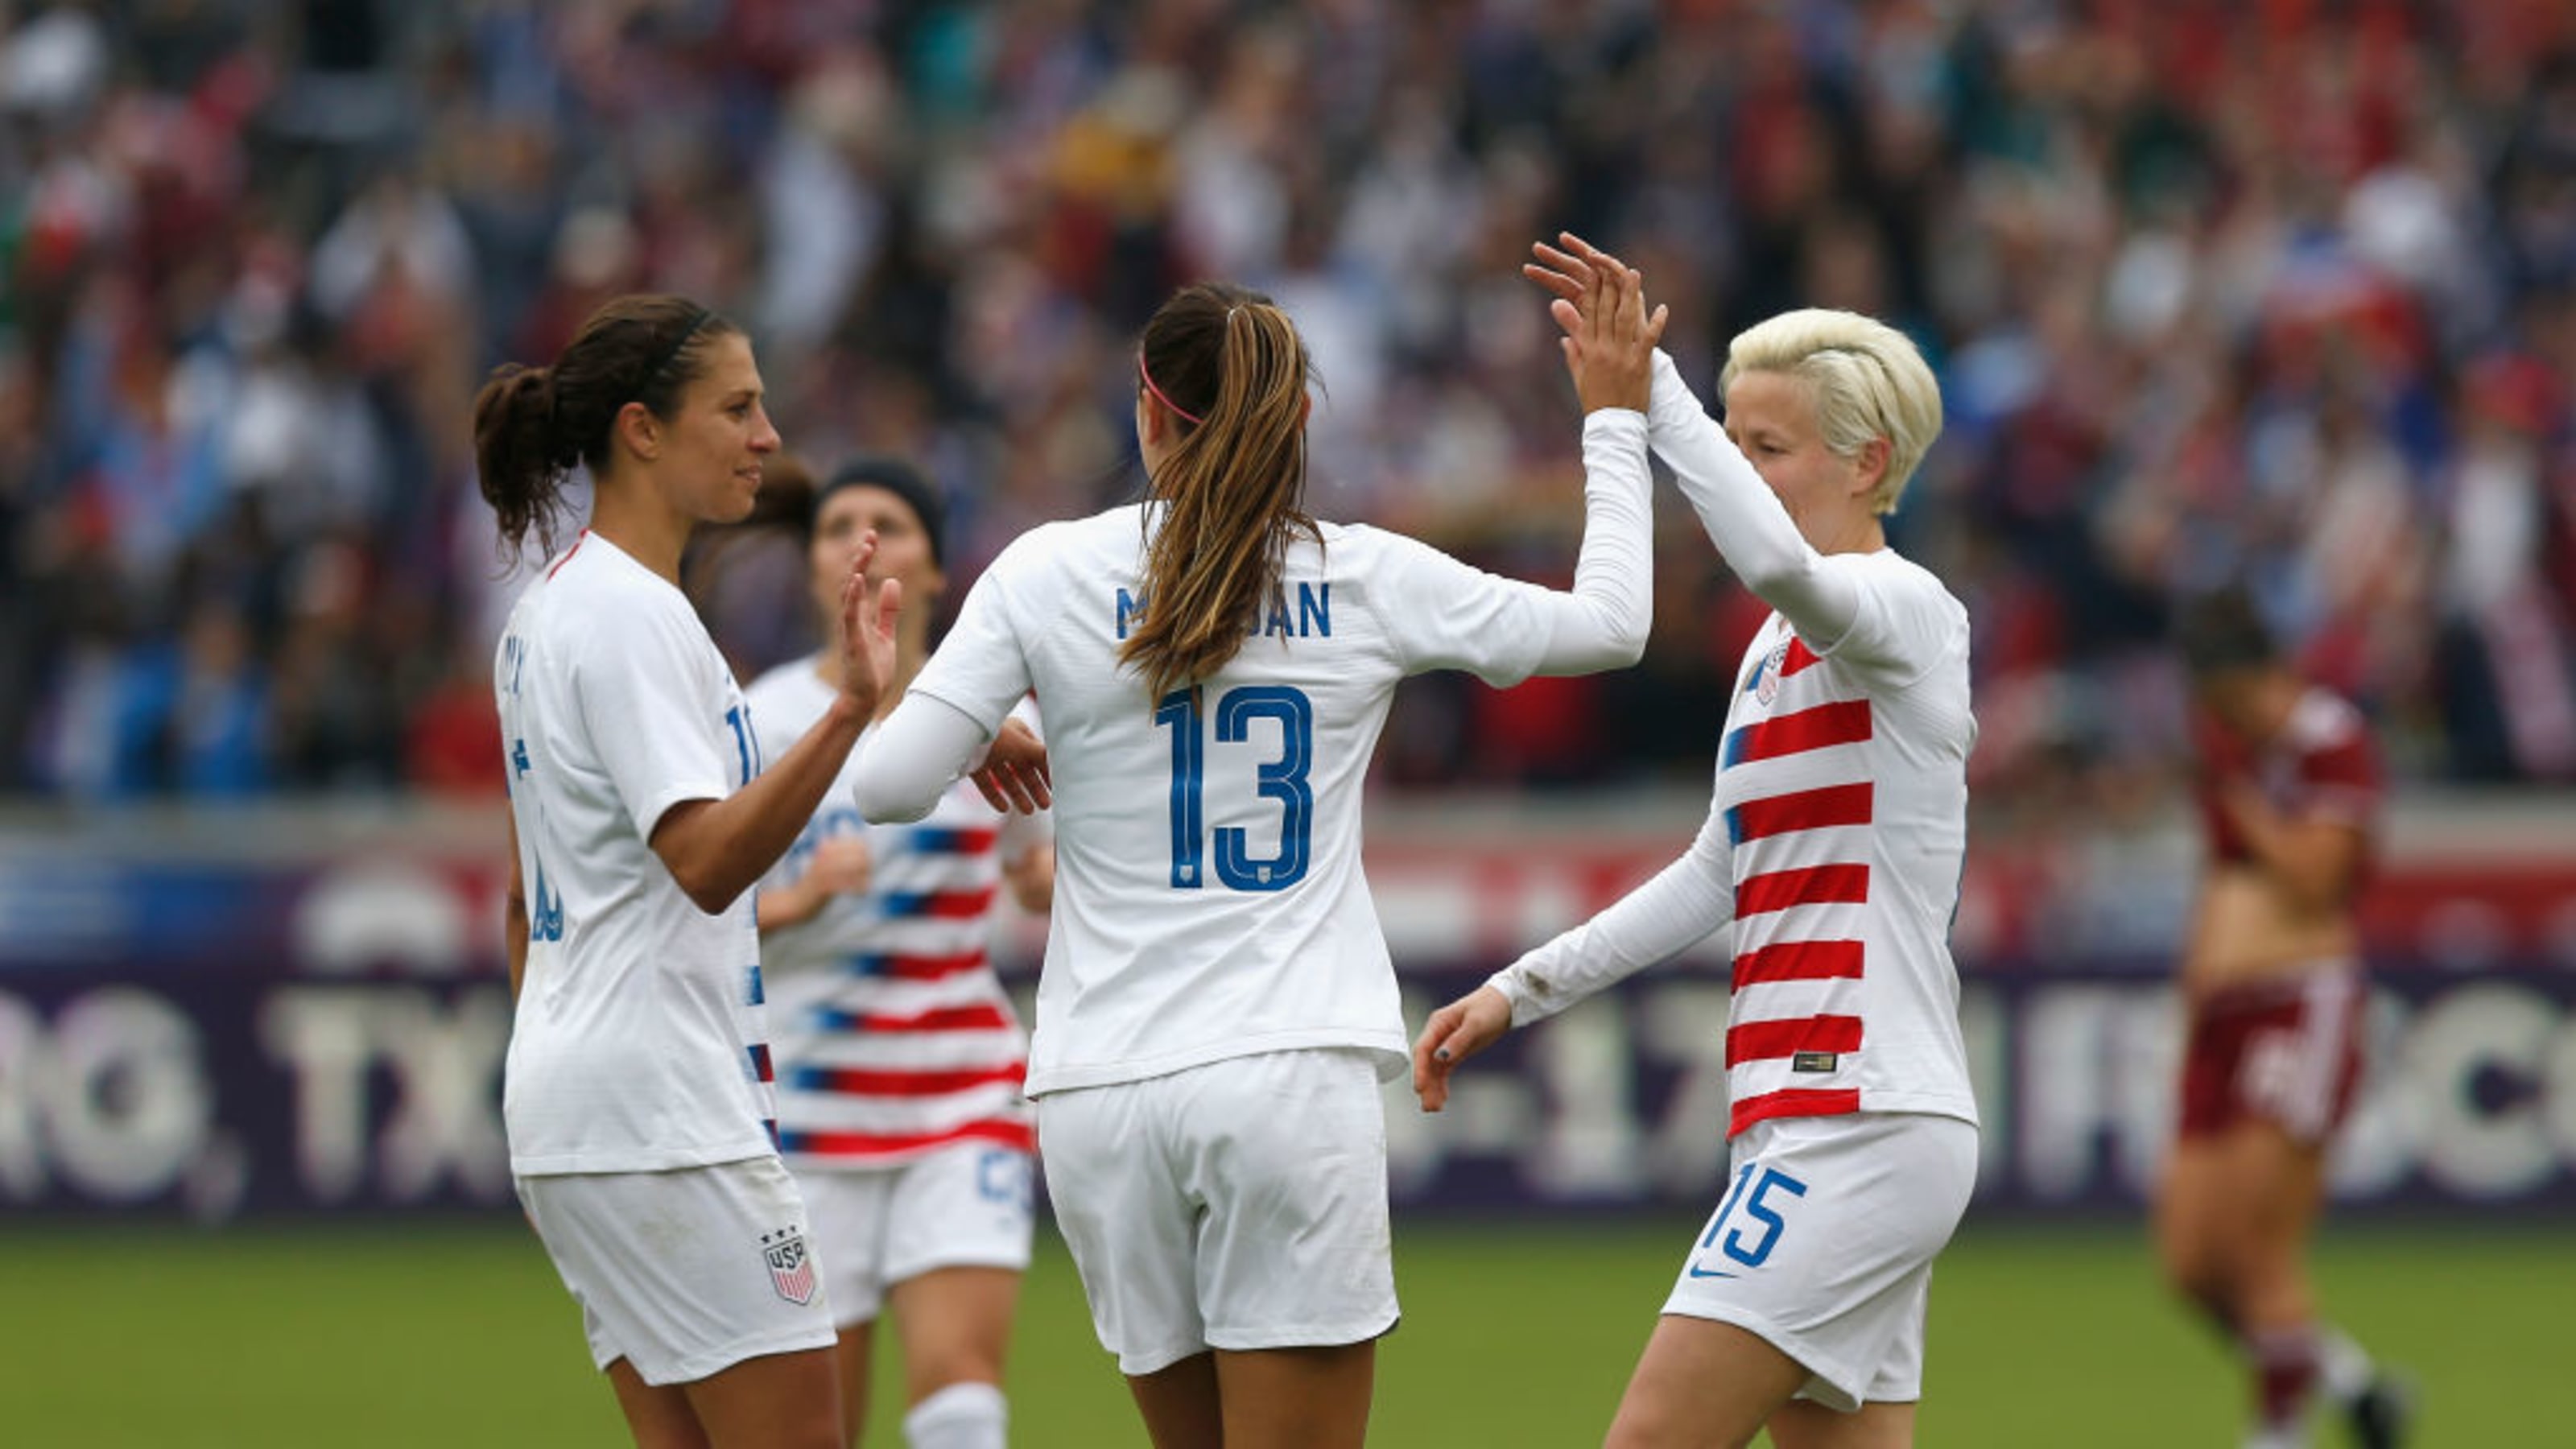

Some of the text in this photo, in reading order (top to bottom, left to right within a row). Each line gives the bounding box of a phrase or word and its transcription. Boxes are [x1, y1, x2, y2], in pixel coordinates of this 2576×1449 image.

[1116, 581, 1331, 640] MAN
[1154, 684, 1314, 891] 13
[1703, 1162, 1808, 1269] 15
